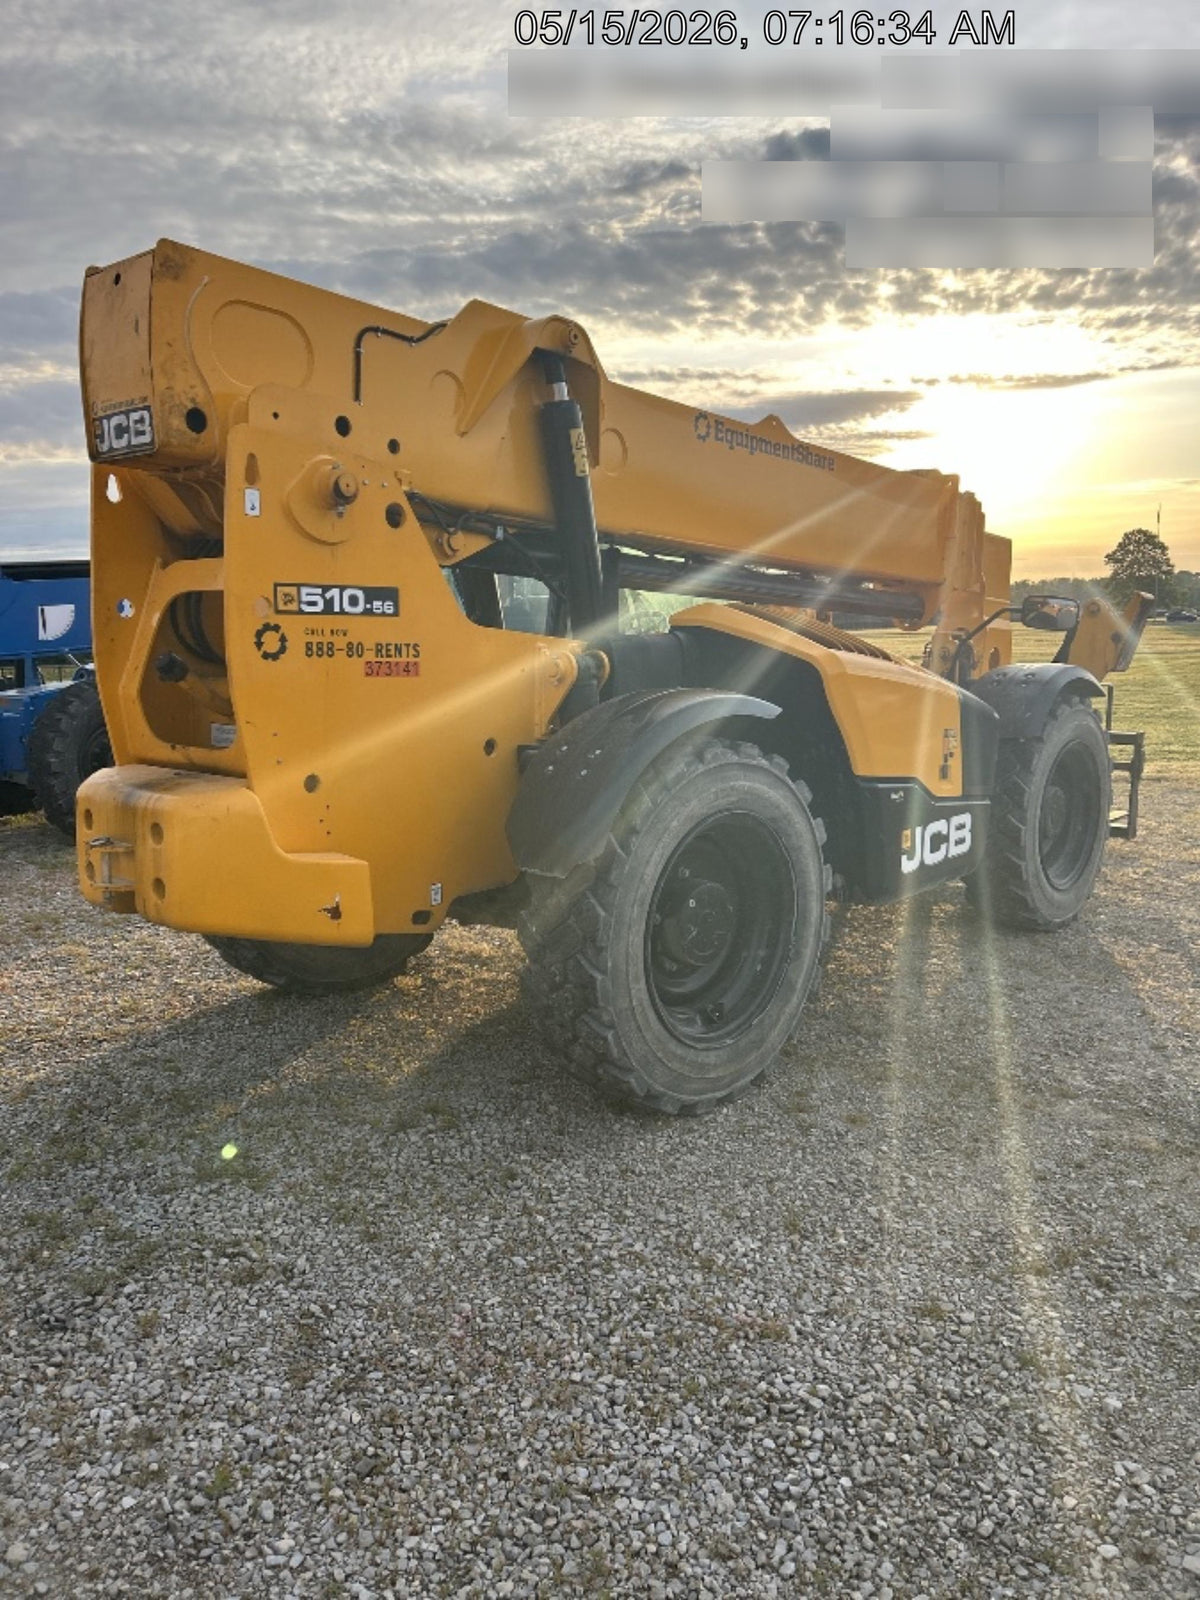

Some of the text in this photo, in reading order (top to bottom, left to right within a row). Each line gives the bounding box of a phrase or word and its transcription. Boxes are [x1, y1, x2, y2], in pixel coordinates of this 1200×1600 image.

[96, 410, 152, 452] JCB
[714, 419, 835, 471] EquipmentShare
[300, 586, 394, 613] 510-56
[304, 627, 326, 636] CALL
[305, 641, 420, 658] 888-80-RENTS
[365, 661, 419, 676] 373141
[901, 812, 971, 873] JCB
